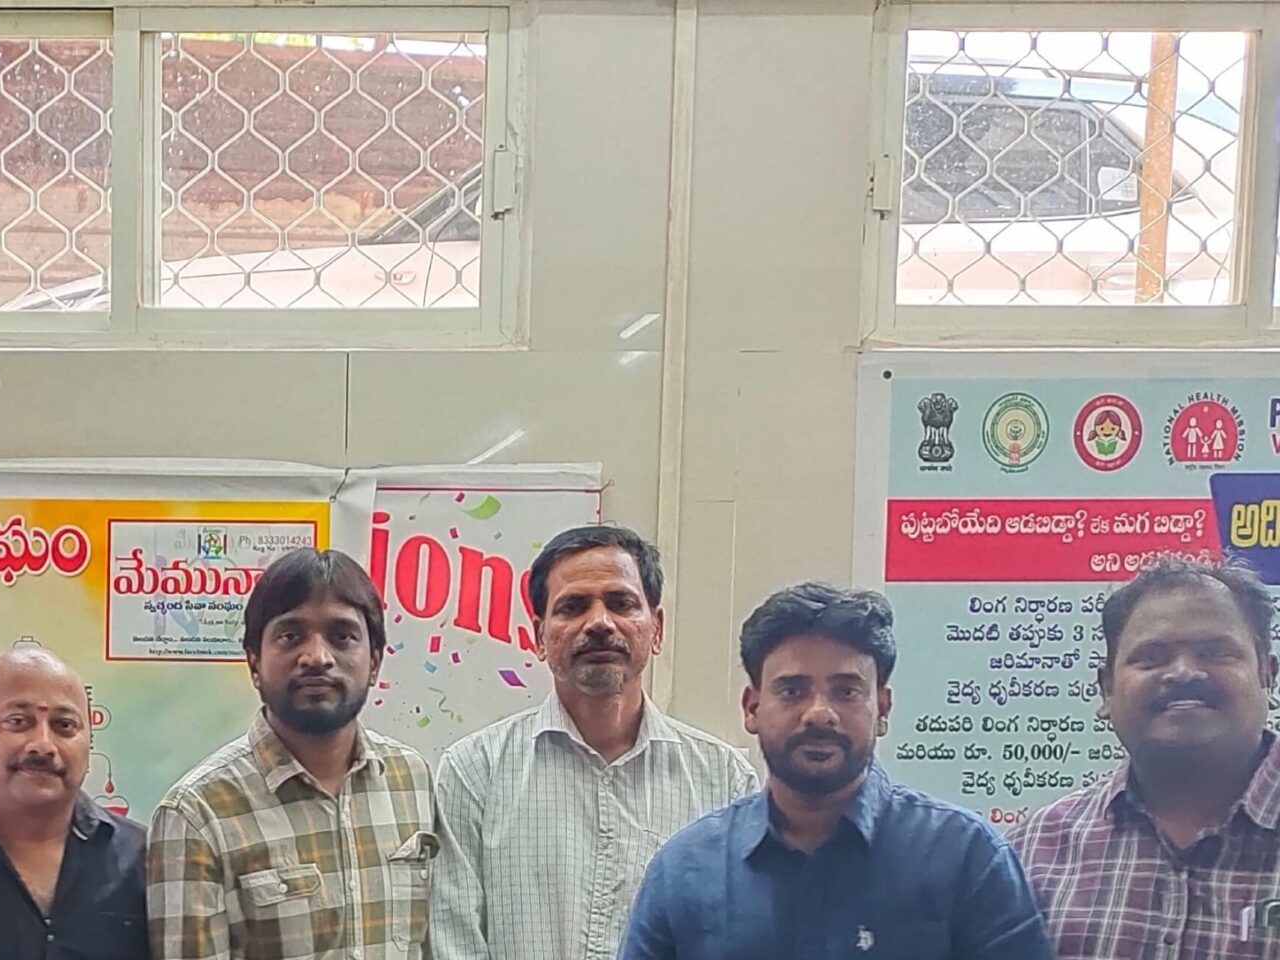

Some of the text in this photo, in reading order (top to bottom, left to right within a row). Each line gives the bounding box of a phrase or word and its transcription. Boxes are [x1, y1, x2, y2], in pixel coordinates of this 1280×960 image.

[1163, 403, 1185, 466] NATIONAL
[1188, 391, 1229, 405] HEALTH
[1231, 406, 1246, 462] MISSION
[900, 508, 1001, 542] పుట్టబోయేది
[1090, 516, 1110, 534] లేక
[1113, 511, 1150, 534] మగ
[1090, 552, 1120, 572] అని
[969, 596, 1008, 614] లింగ
[946, 623, 1001, 642] మొదటి
[1008, 623, 1064, 648] తప్పుకు
[1072, 625, 1084, 642] 3
[989, 648, 1080, 670] జరిమానాతో
[947, 680, 982, 705] వైద్య
[915, 715, 974, 733] తదుపరి
[981, 715, 1020, 733] లింగ
[896, 743, 956, 760] మరియు
[1002, 741, 1081, 764] 50,000/-
[961, 771, 996, 796] వైద్య
